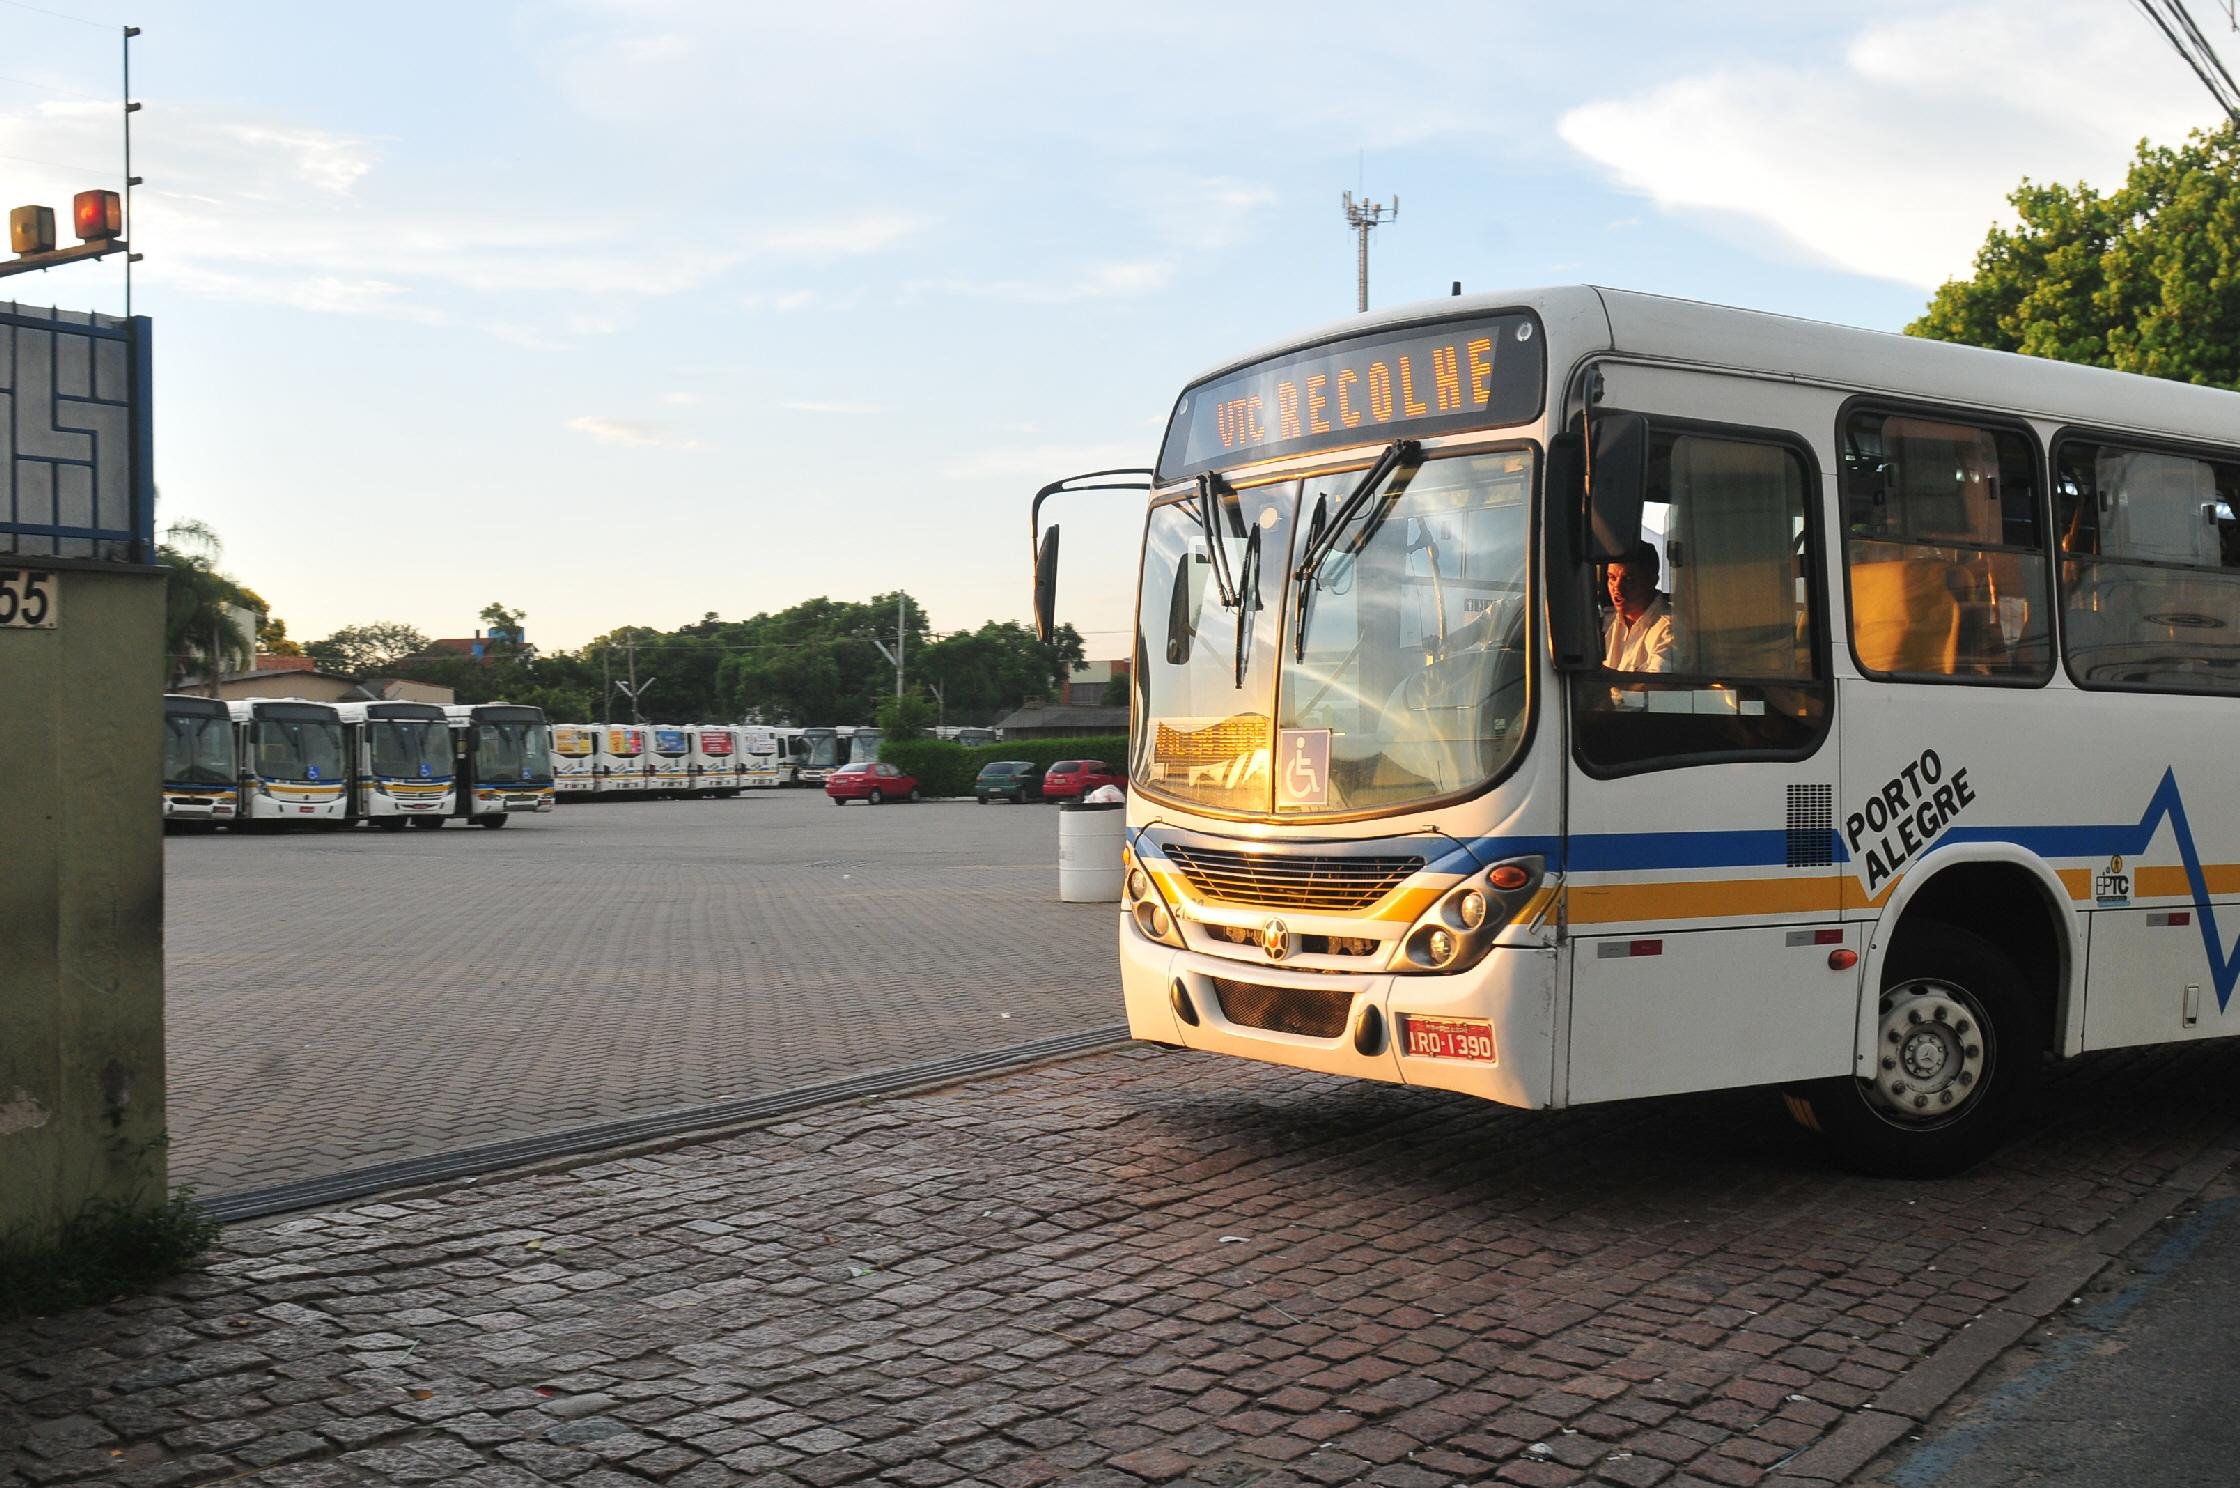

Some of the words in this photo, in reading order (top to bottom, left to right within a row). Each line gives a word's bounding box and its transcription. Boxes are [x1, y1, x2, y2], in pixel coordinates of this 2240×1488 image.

[1277, 337, 1492, 441] RECOLHE
[1846, 748, 1943, 854] PORTO
[1864, 766, 1977, 892] ALEGRE
[2095, 875, 2130, 896] EPTC
